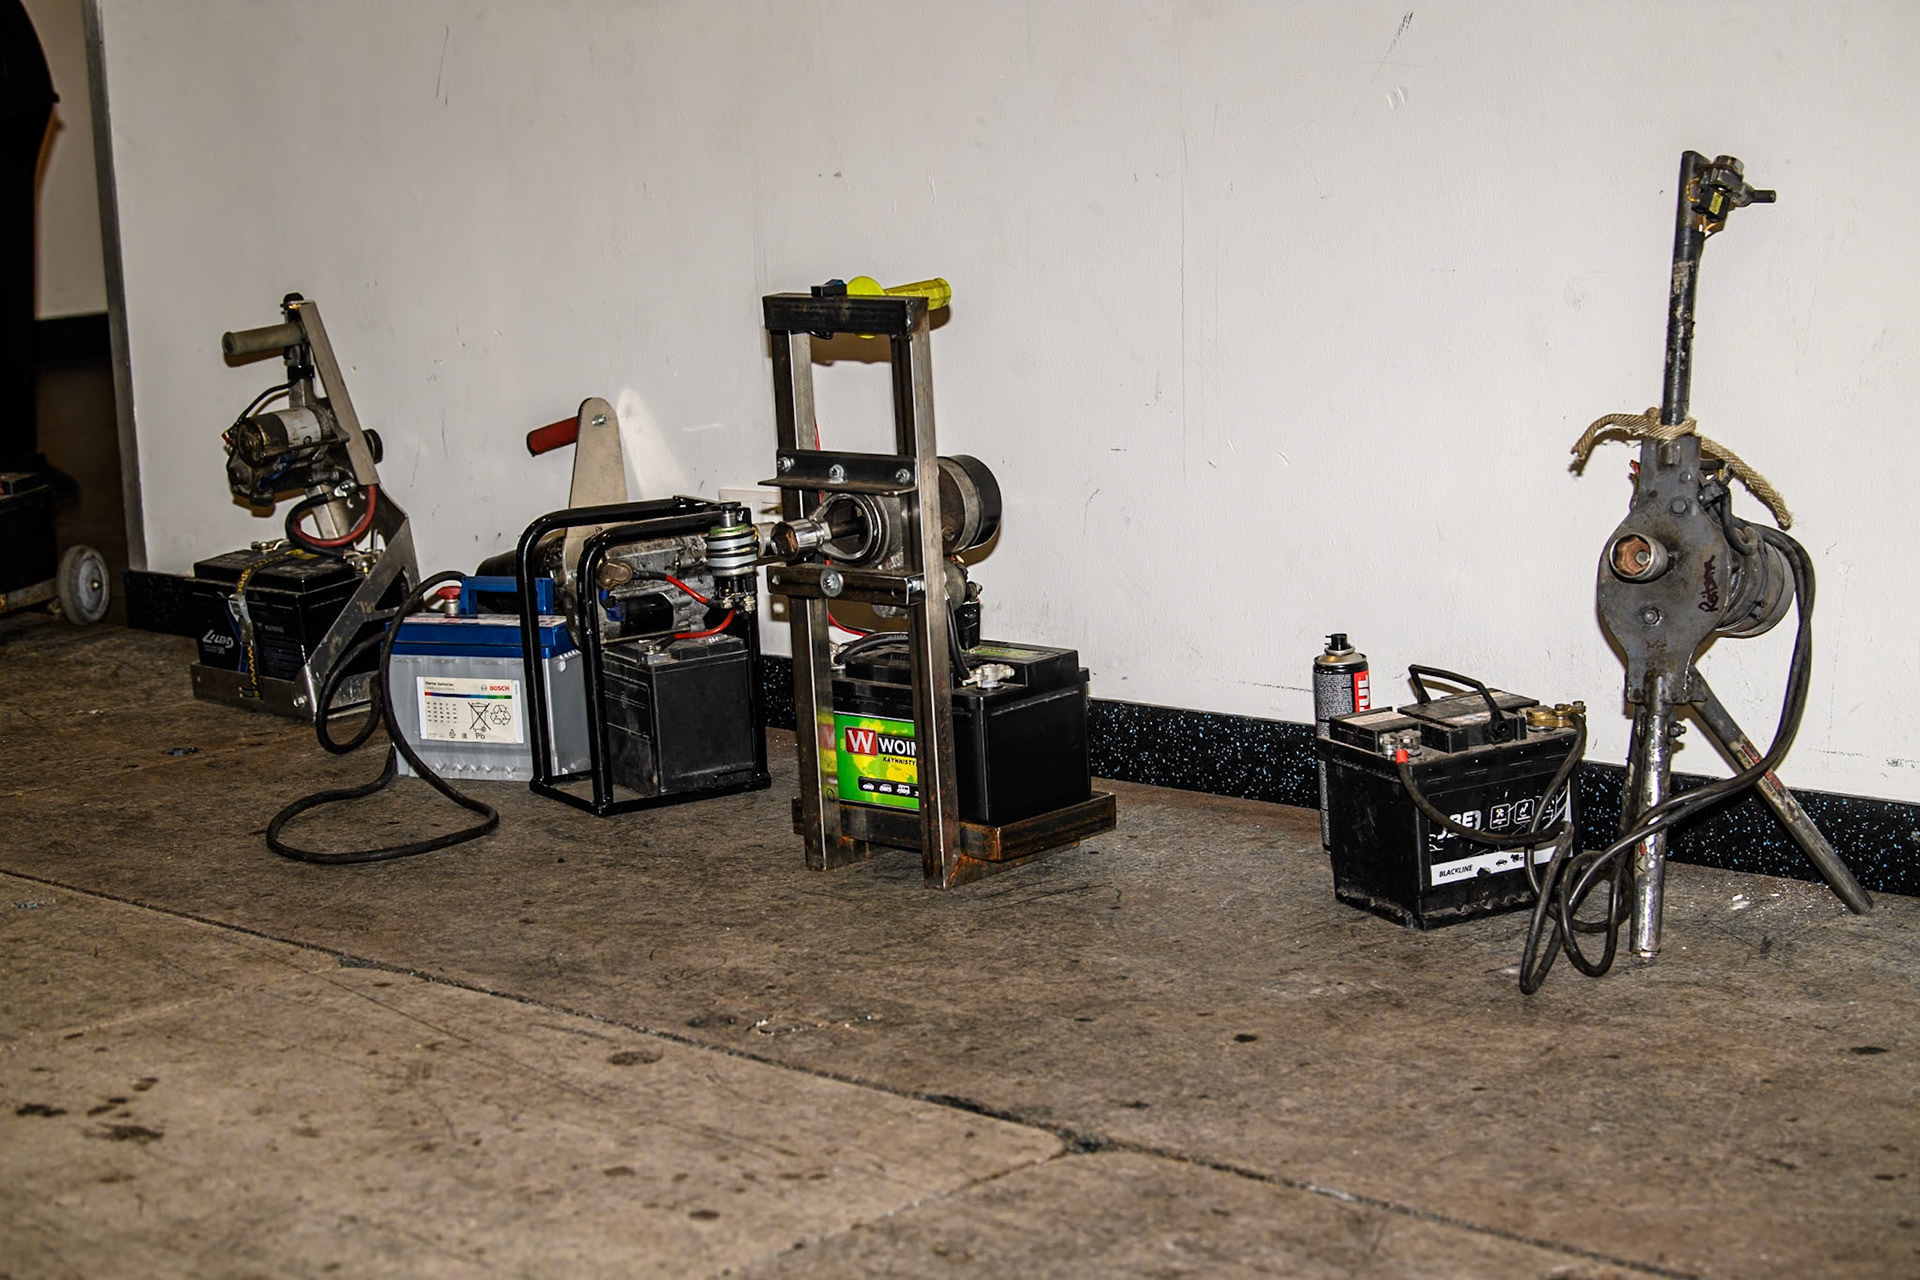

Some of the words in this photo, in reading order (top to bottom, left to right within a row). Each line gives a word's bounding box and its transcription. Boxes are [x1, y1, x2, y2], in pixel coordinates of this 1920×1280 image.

[475, 732, 486, 740] Pb
[847, 729, 874, 754] W
[1439, 864, 1473, 878] BLACKLINE
